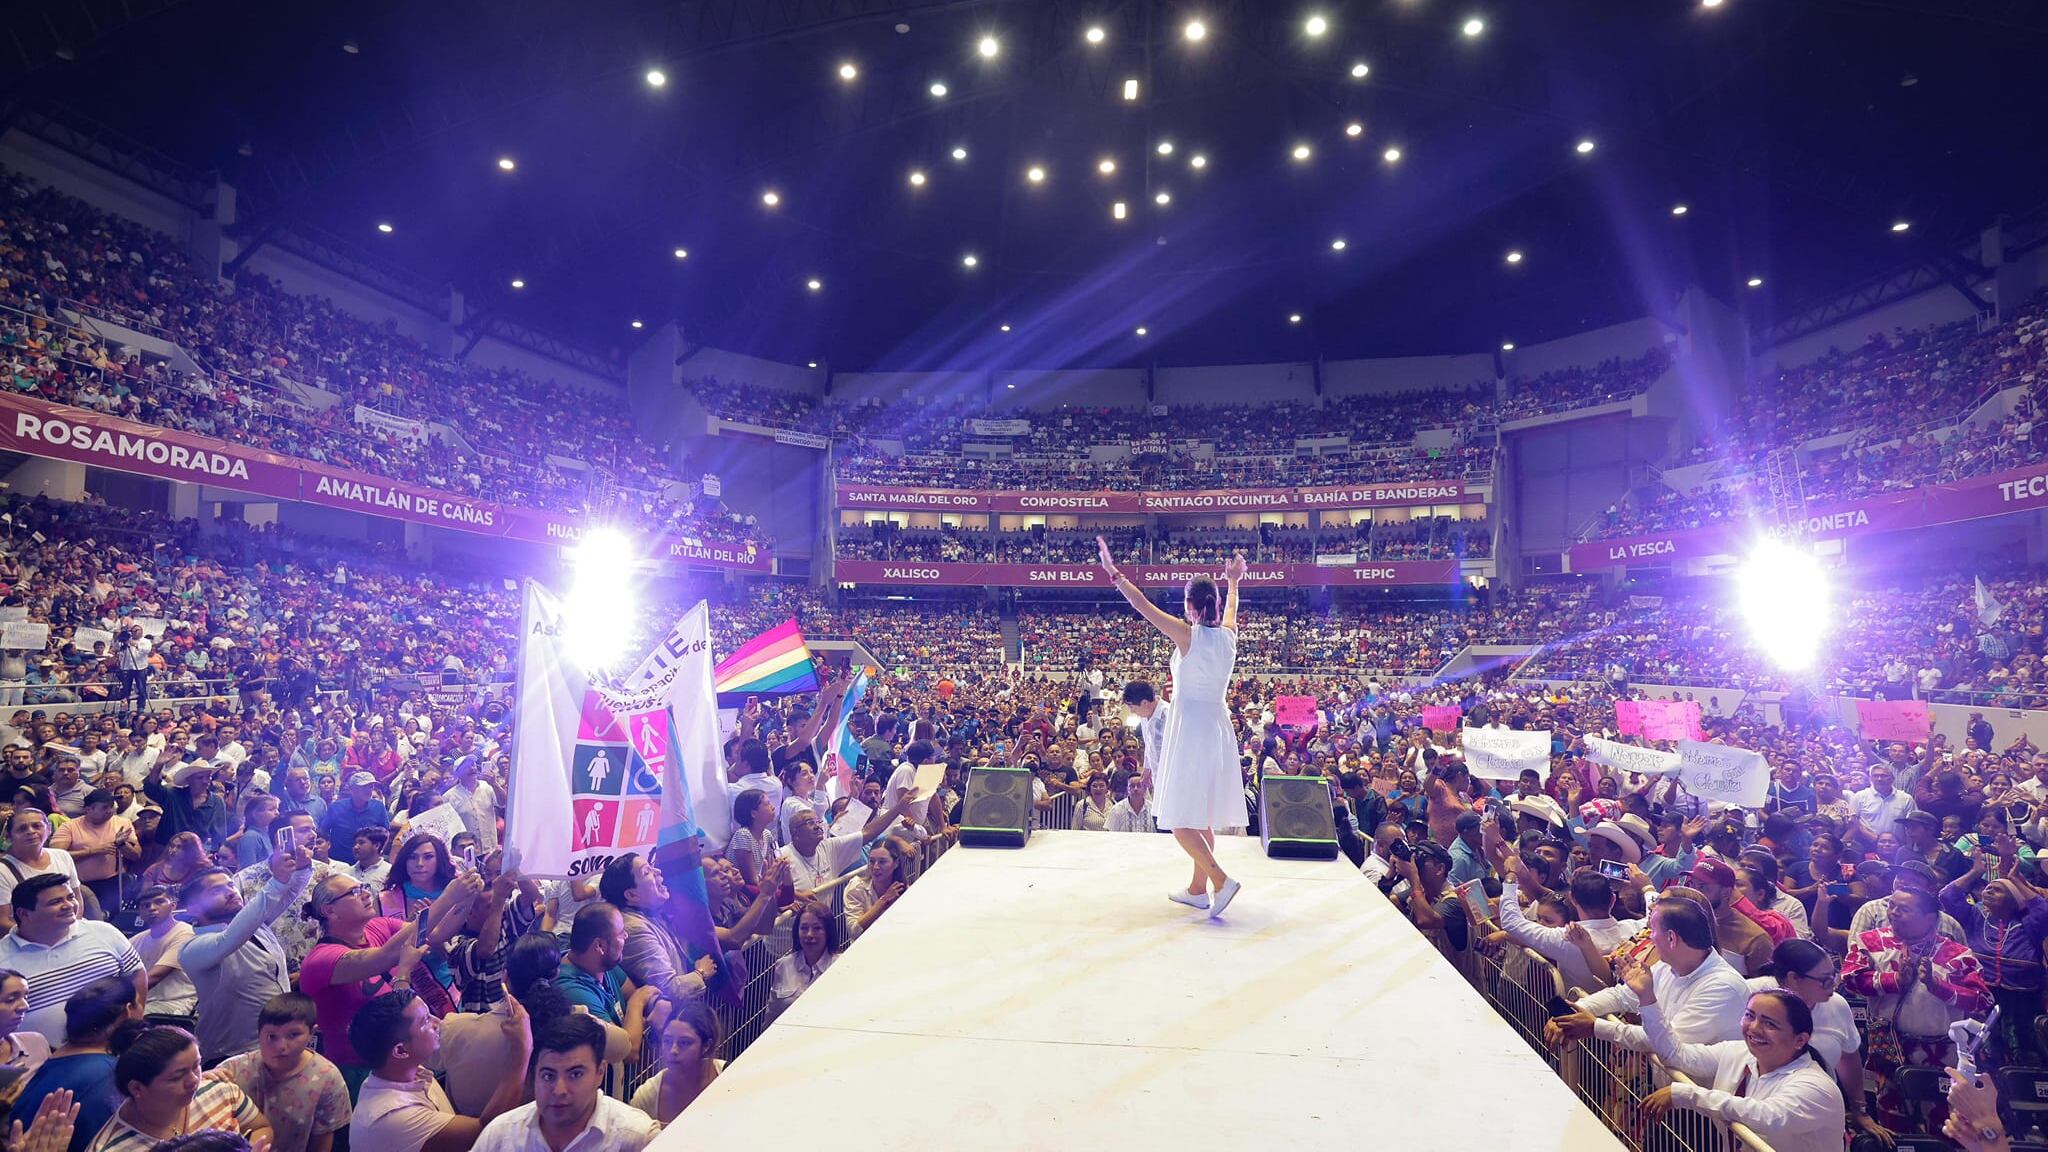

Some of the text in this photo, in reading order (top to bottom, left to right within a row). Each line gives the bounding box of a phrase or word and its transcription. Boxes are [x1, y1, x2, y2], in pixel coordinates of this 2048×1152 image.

[16, 413, 249, 479] ROSAMORADA
[1131, 446, 1167, 455] CLAUDIA
[316, 475, 493, 527] AMATLÁN DE CAÑAS
[849, 490, 978, 506] SANTA MARÍA DEL ORO
[1020, 495, 1109, 508] COMPOSTELA
[1146, 493, 1289, 508] SANTIAGO IXCUINTLA
[1304, 485, 1458, 505] BAHÍA DE BANDERAS
[714, 549, 735, 563] DEL
[1610, 540, 1676, 560] LA YESCA
[883, 567, 940, 580] XALISCO
[1030, 569, 1094, 582] SAN BLAS
[1145, 572, 1168, 581] SAN
[1213, 571, 1285, 581] LANILLAS
[1353, 567, 1396, 581] TEPIC
[1694, 771, 1743, 793] Claudia
[567, 854, 614, 877] som
